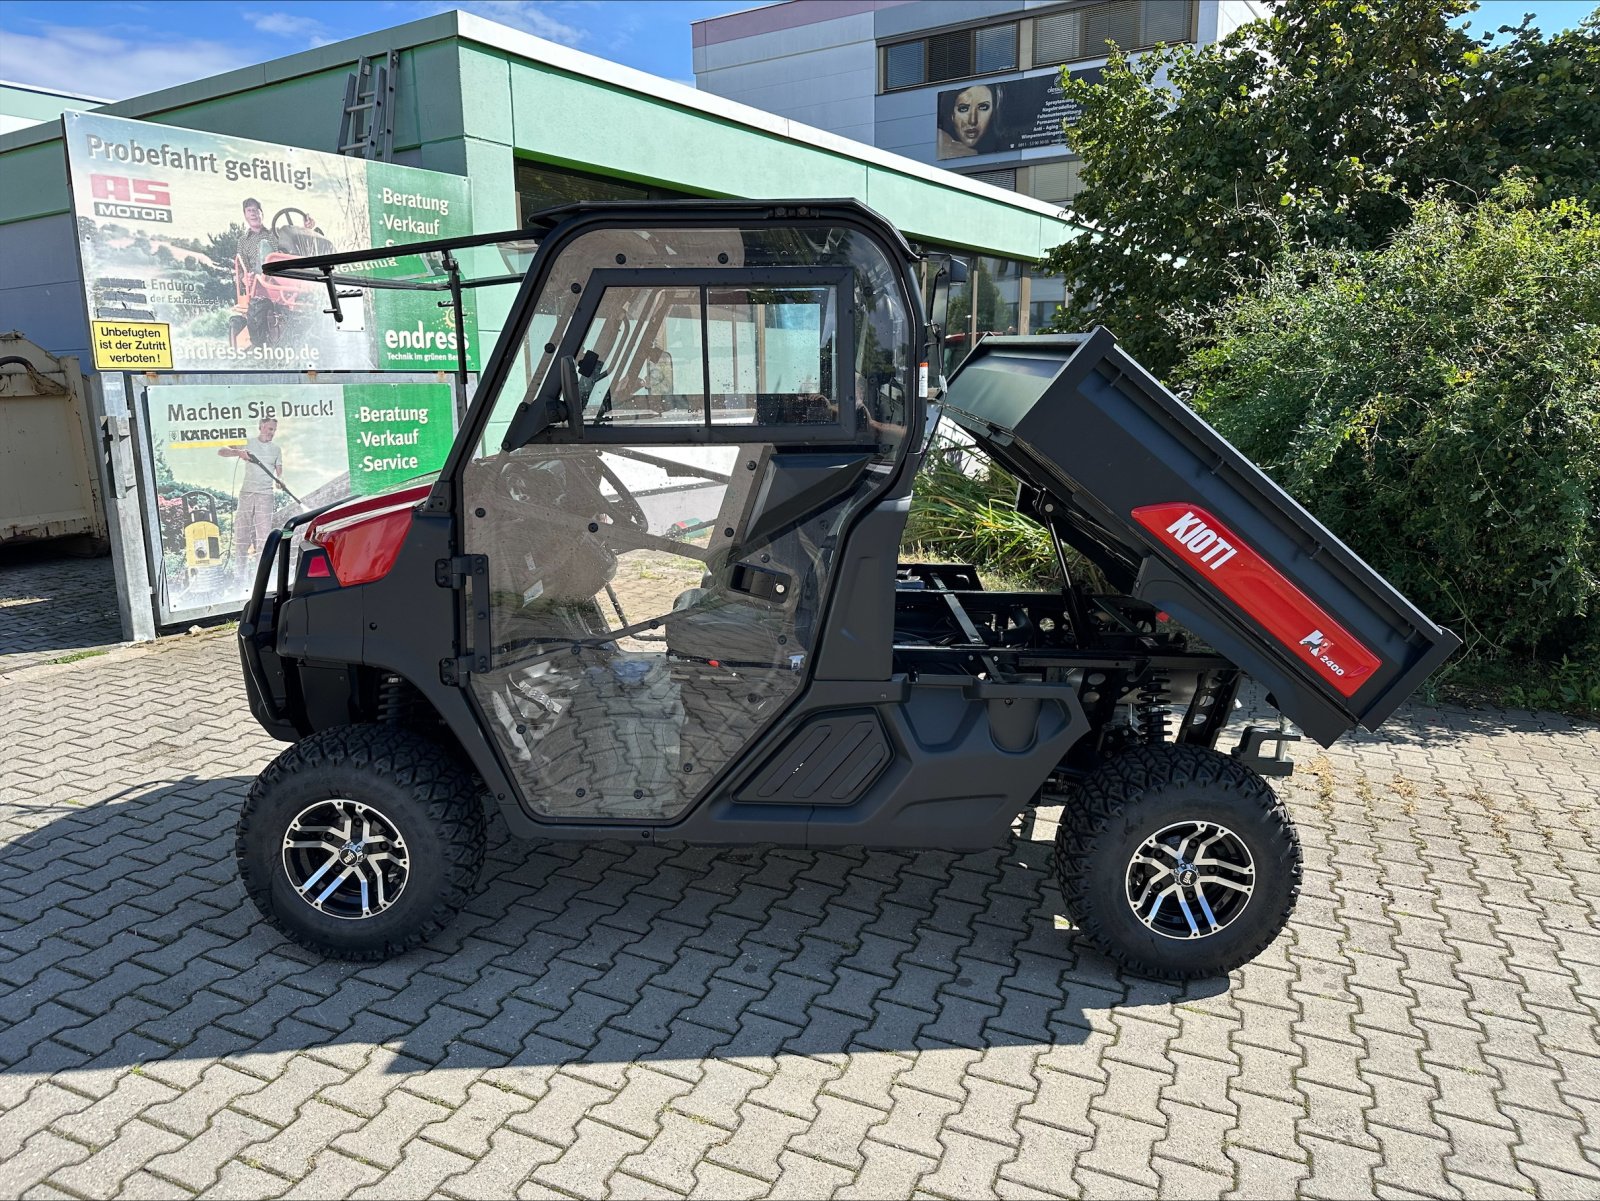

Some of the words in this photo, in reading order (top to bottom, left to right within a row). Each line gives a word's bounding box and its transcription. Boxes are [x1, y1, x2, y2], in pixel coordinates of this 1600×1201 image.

[87, 134, 218, 173] Probefahrt
[225, 158, 313, 190] gefällig!
[90, 174, 171, 206] AS
[383, 187, 449, 215] Beratung
[98, 204, 169, 221] MOTOR
[383, 213, 440, 235] Verkauf
[150, 279, 195, 293] Enduro
[150, 294, 166, 303] der
[168, 294, 219, 306] Extraklasse
[101, 326, 161, 339] Unbefugten
[100, 340, 113, 350] ist
[115, 340, 132, 350] der
[135, 340, 167, 351] Zutritt
[174, 343, 319, 364] endress-shop.de
[386, 352, 414, 361] Technik
[414, 353, 422, 361] im
[424, 353, 447, 362] grünen
[167, 402, 242, 422] Machen
[248, 402, 276, 419] Sie
[282, 399, 334, 418] Druck!
[360, 405, 429, 424] Beratung
[180, 427, 247, 442] KÄRCHER
[361, 429, 419, 448] Verkauf
[363, 453, 418, 472] Service
[1166, 511, 1238, 571] KIOTI
[1320, 655, 1345, 676] 2400
